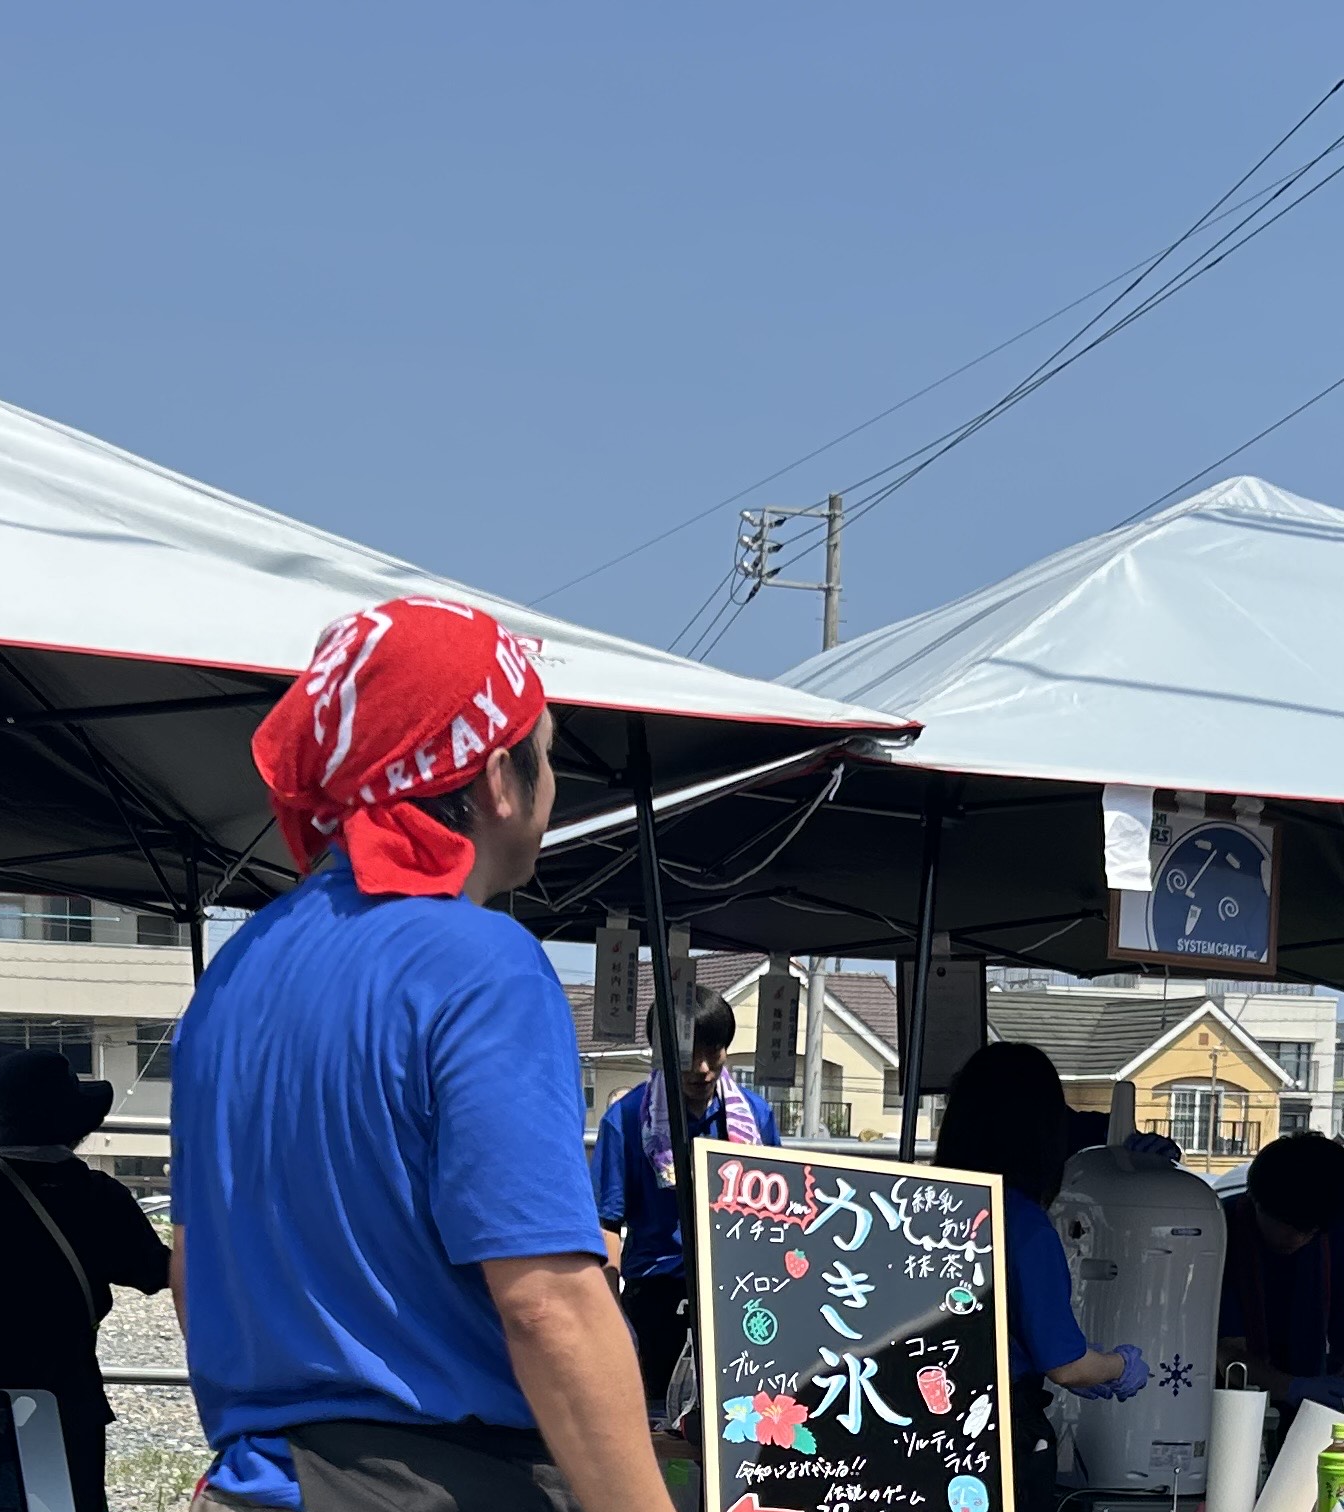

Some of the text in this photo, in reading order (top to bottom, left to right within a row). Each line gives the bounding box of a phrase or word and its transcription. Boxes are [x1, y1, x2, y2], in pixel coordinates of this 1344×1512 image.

[1177, 938, 1247, 959] SYSTEMCRAFT
[717, 1159, 789, 1212] 100
[911, 1186, 963, 1216] 練乳
[904, 1254, 964, 1280] 抹茶
[804, 1176, 913, 1435] かき氷
[757, 1371, 800, 1393] ハワイ
[943, 1453, 991, 1474] ライチ
[823, 1482, 926, 1505] 伝説のゲーム
